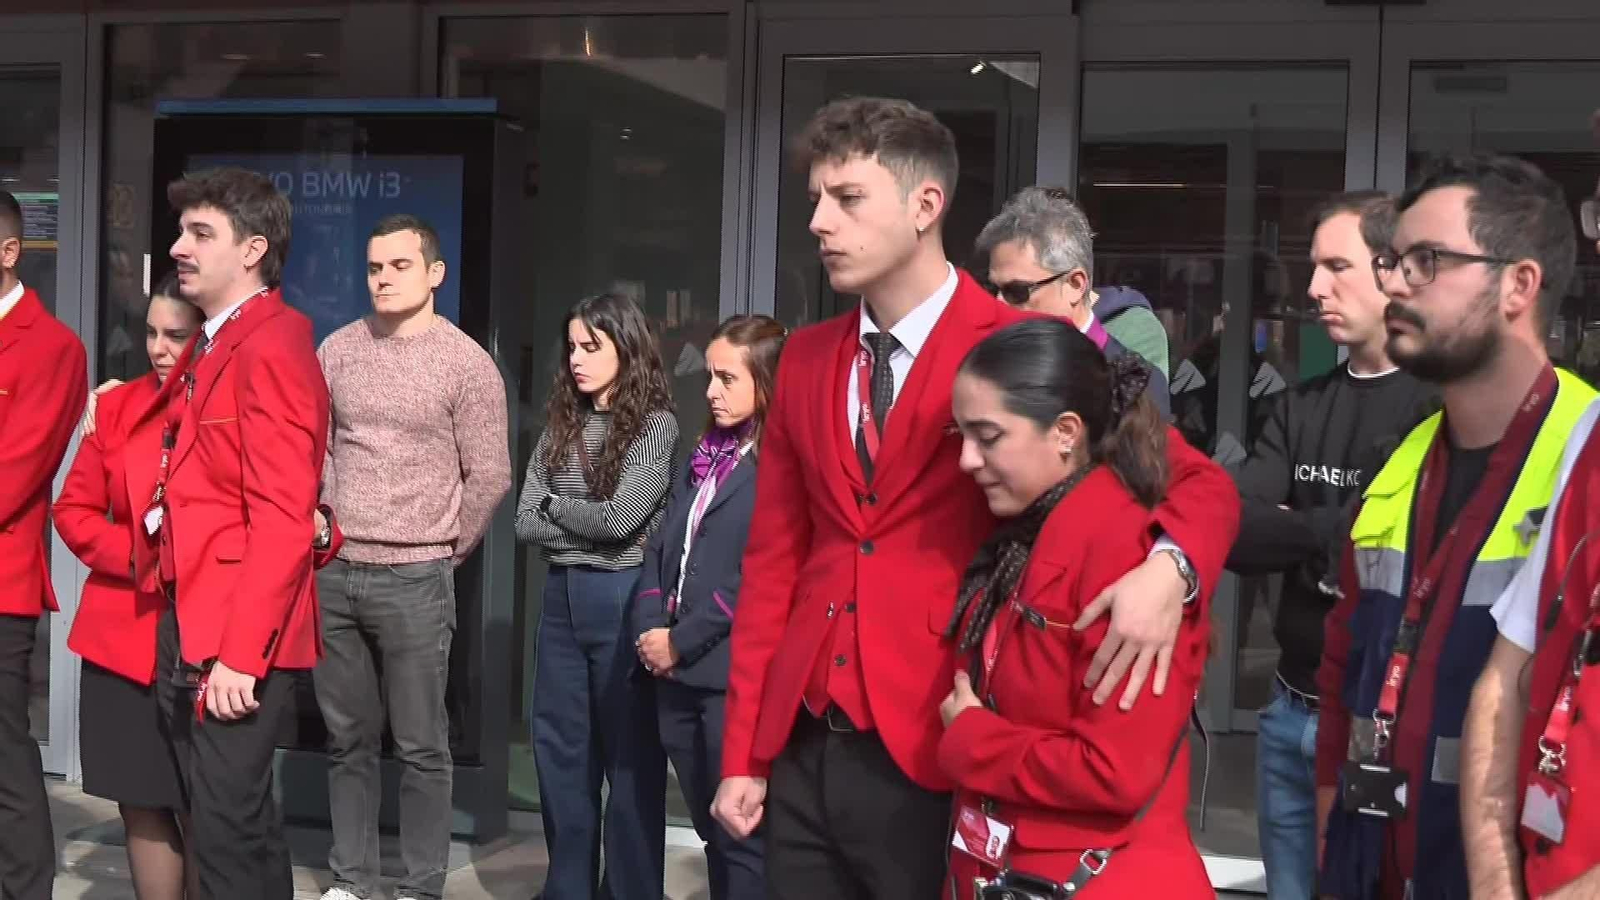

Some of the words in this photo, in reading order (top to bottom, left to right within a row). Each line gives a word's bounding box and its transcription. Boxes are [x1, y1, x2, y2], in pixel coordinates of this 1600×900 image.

[302, 172, 372, 198] BMW
[378, 172, 401, 198] i3
[1294, 464, 1345, 486] ICHAEL
